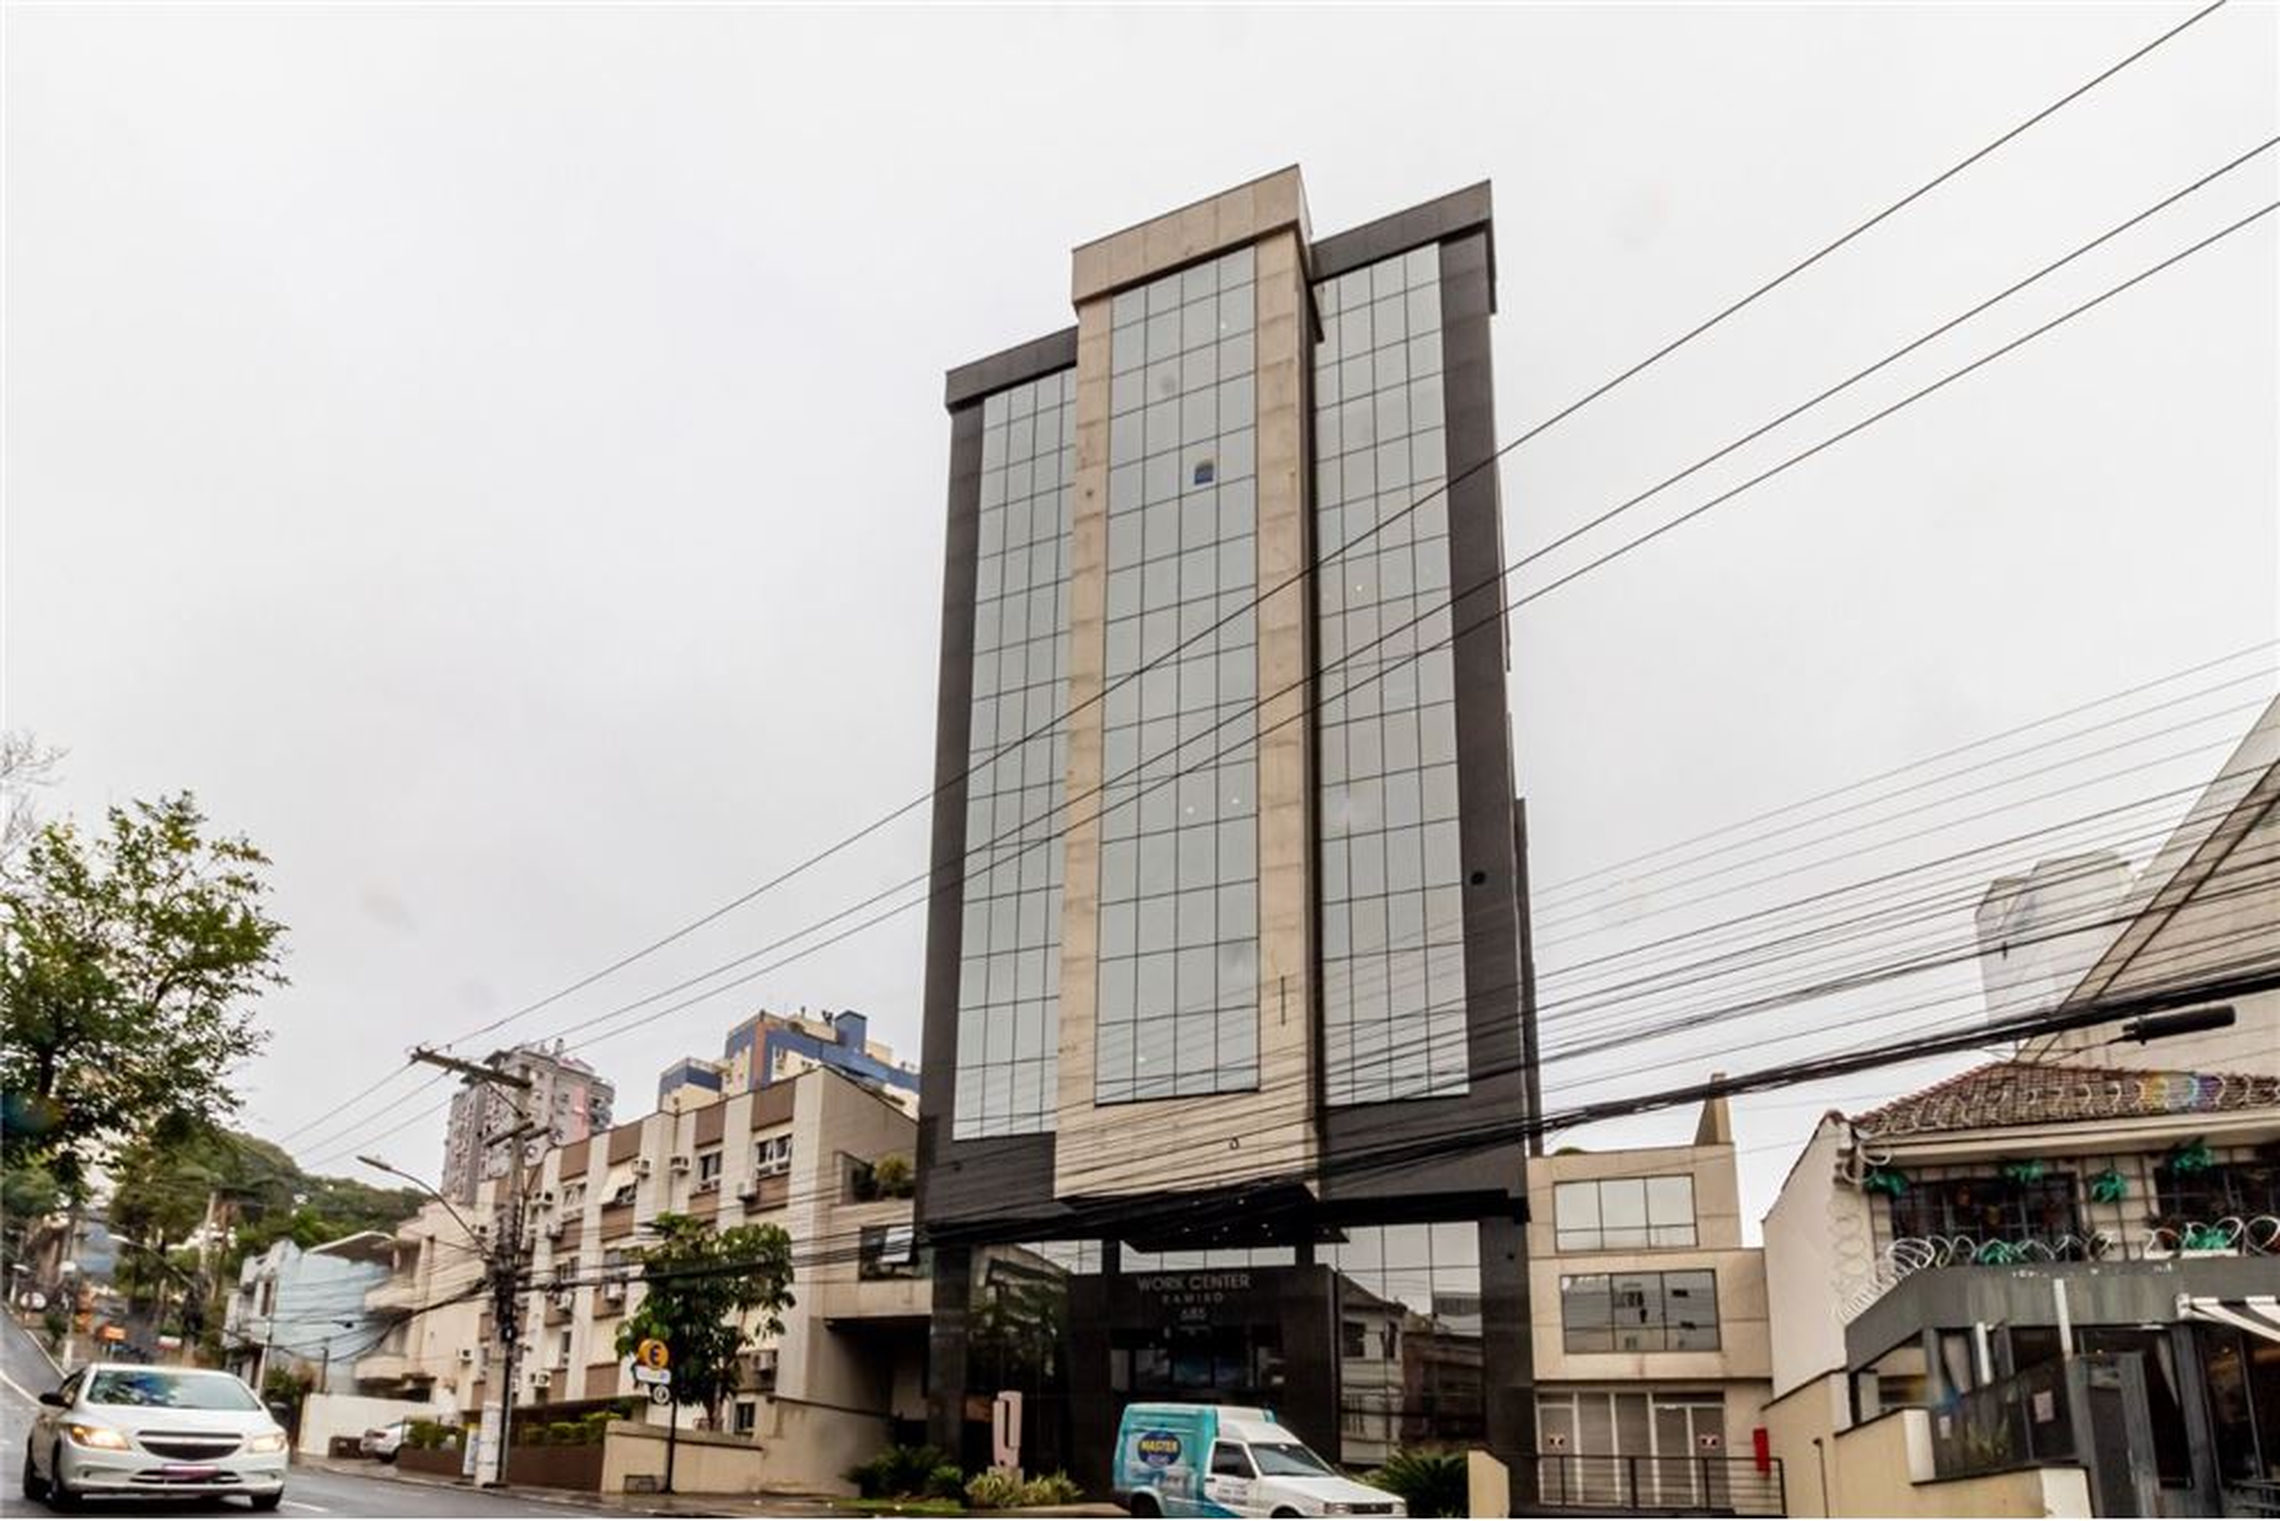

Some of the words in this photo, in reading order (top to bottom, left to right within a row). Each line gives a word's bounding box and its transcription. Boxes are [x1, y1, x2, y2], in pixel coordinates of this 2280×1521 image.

[1137, 1276, 1185, 1292] WORK
[1189, 1274, 1250, 1290] CENTER
[1140, 1440, 1178, 1453] MASTER
